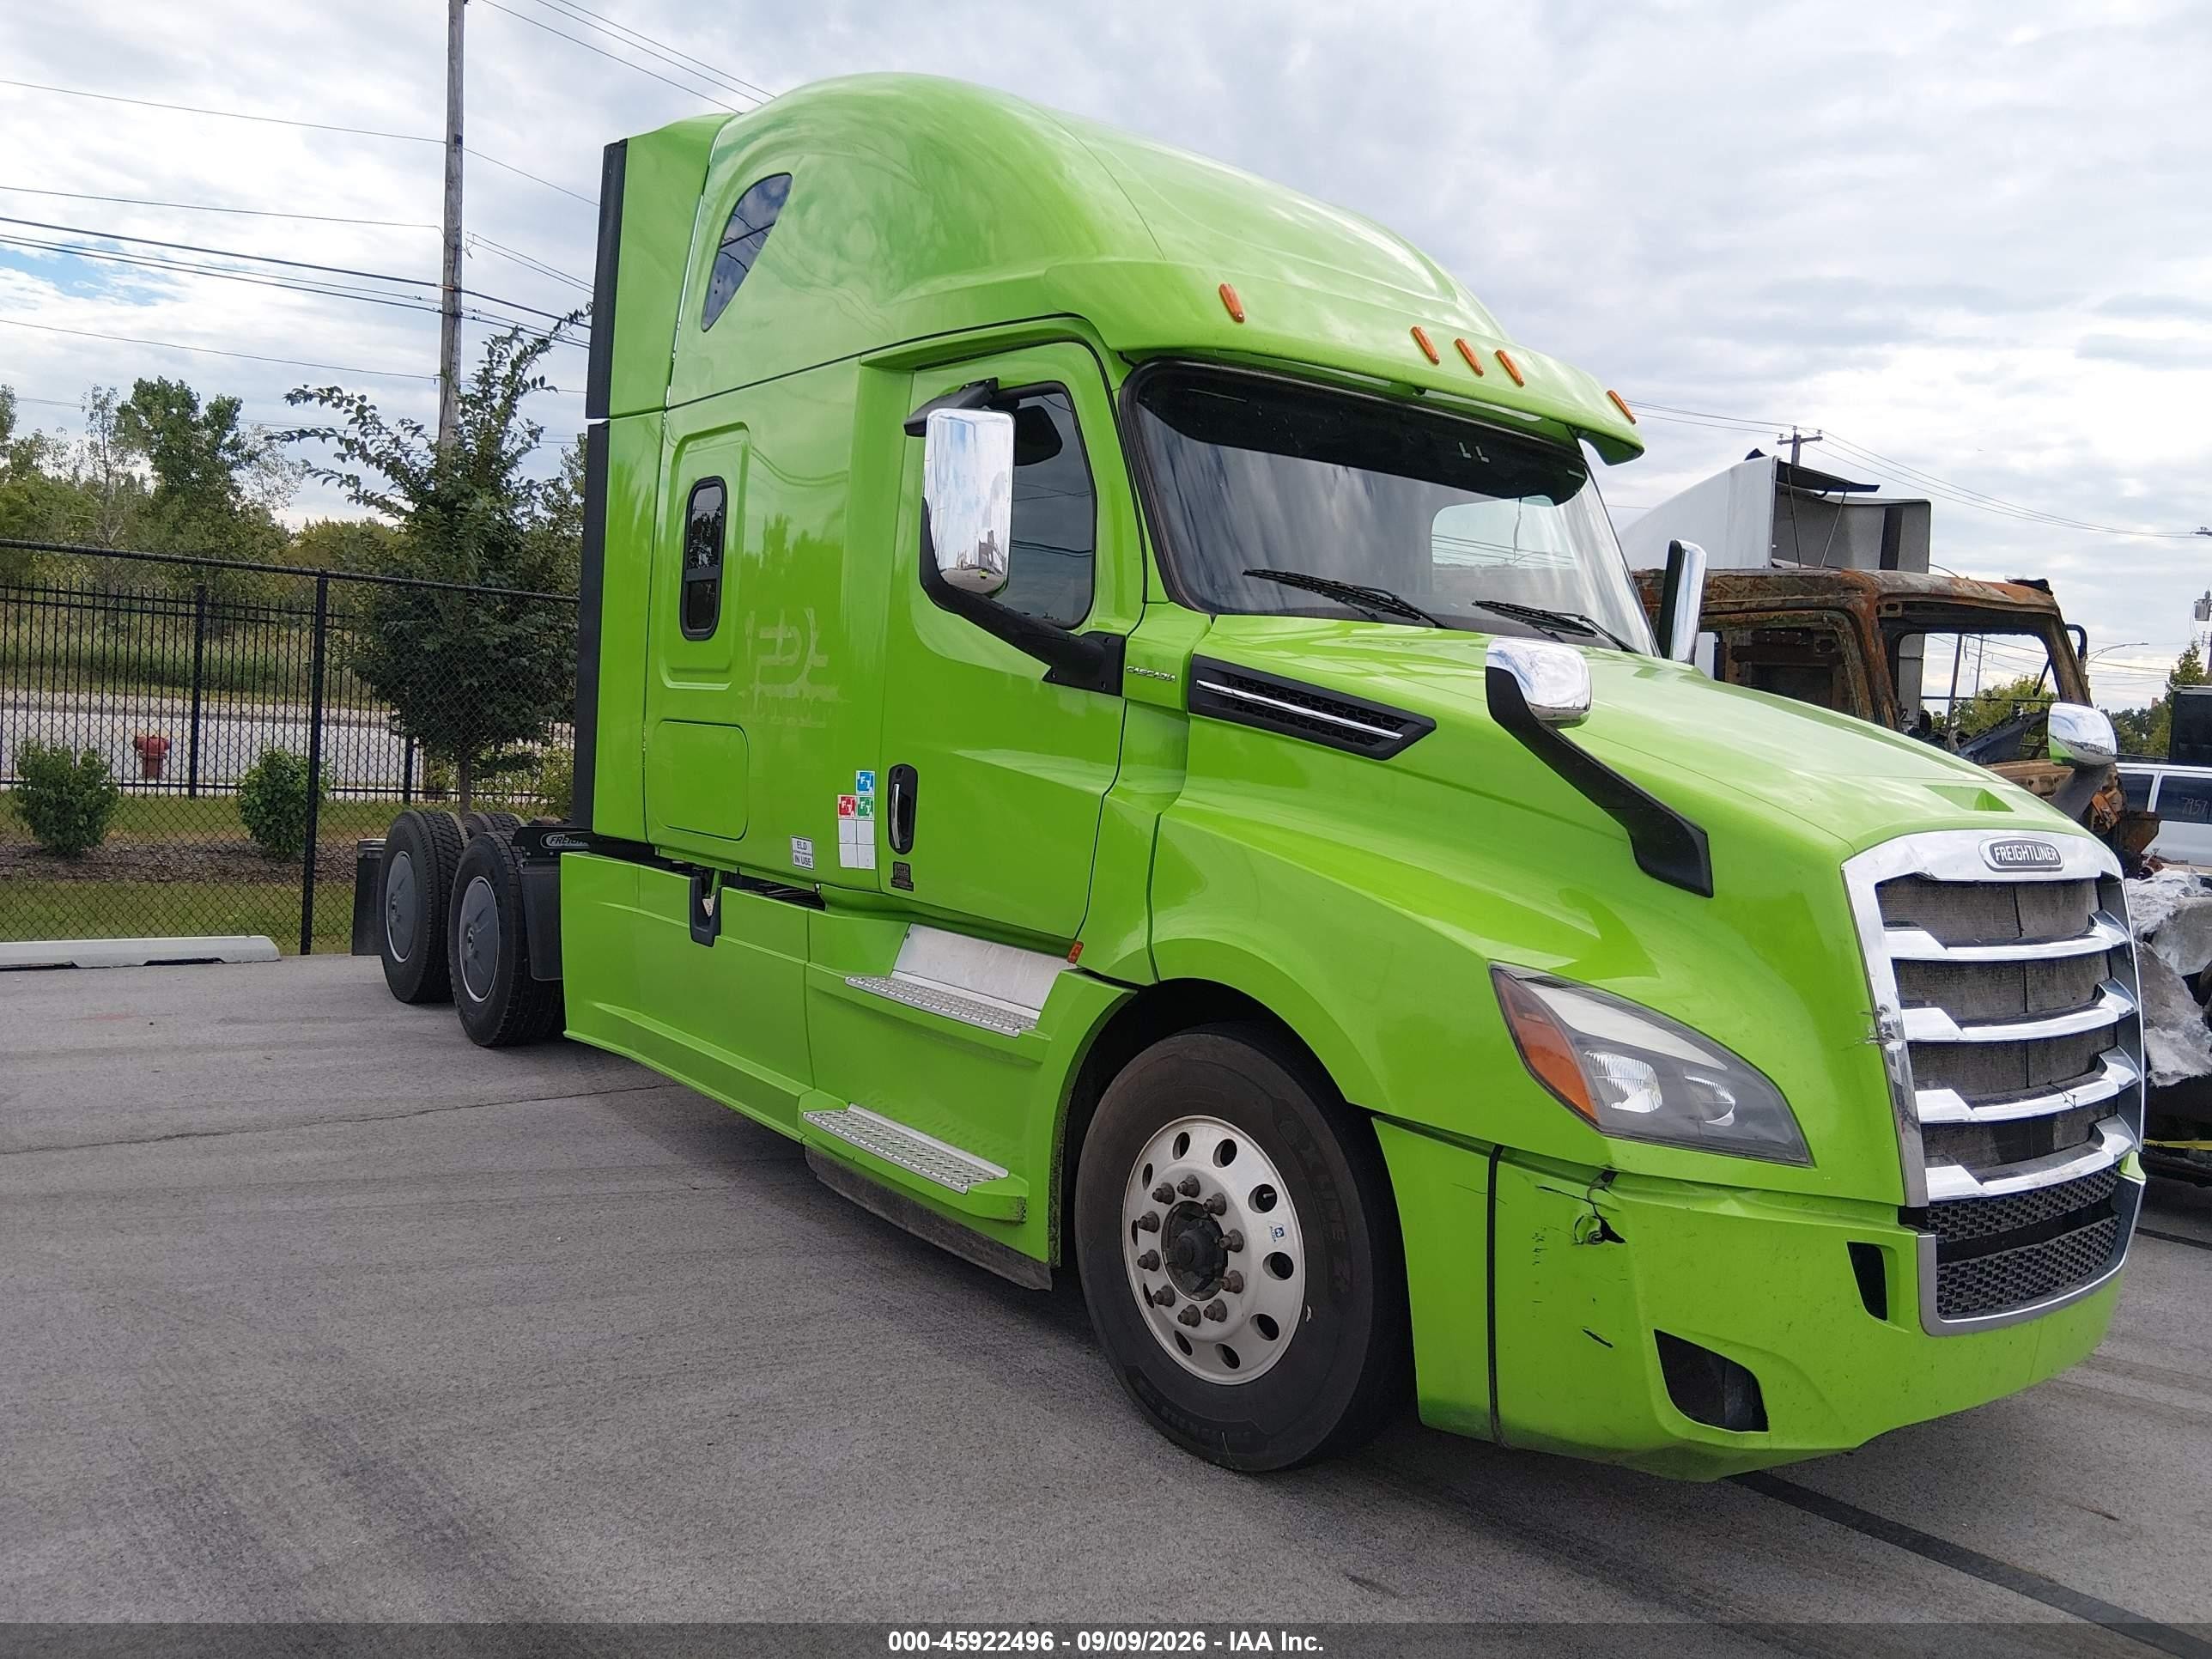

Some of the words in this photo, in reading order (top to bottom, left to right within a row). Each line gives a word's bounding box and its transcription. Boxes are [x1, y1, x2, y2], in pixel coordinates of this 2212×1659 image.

[796, 841, 807, 850] ELD
[1993, 845, 2059, 861] FREIGHTLINER
[801, 855, 812, 867] USE
